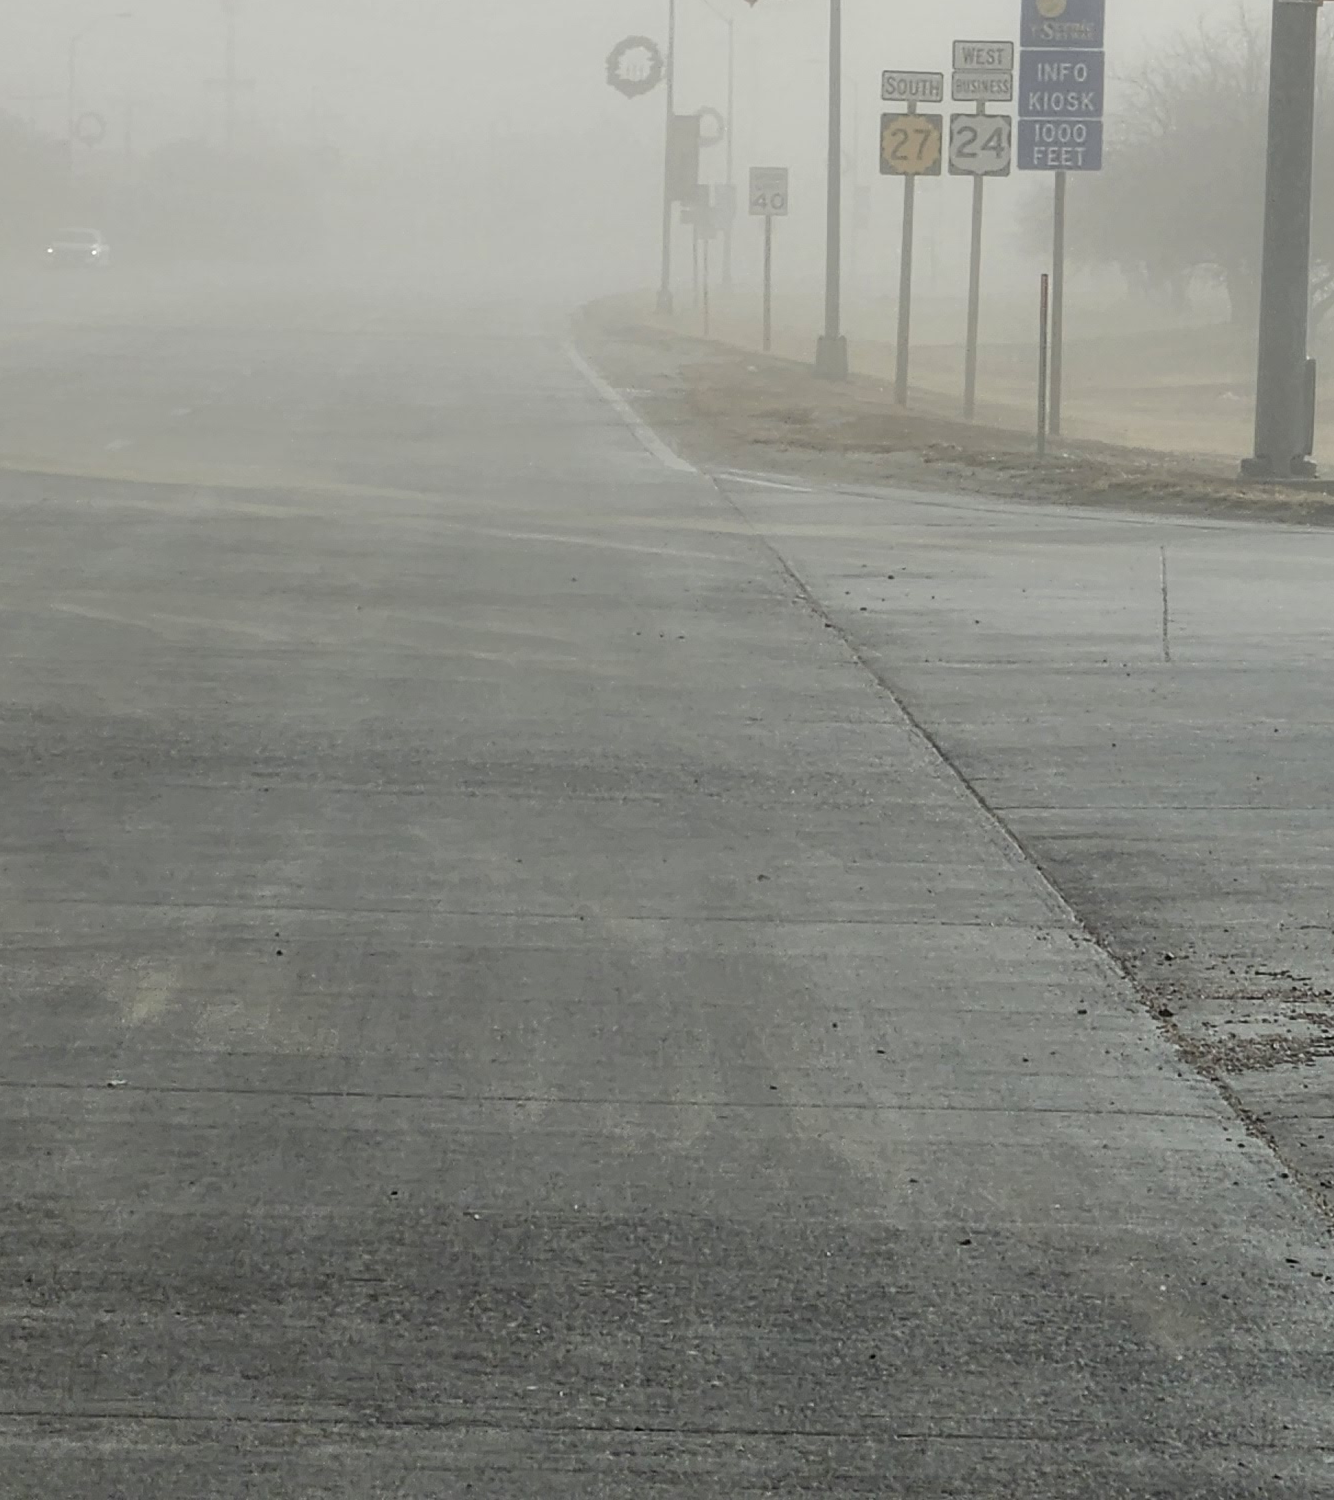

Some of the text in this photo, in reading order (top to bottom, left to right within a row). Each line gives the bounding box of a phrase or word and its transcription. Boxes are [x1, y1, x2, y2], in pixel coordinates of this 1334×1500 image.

[962, 47, 1005, 65] WEST
[1037, 63, 1087, 82] INFO
[885, 76, 940, 97] SOUTH
[955, 79, 1009, 94] BUSINESS
[1028, 91, 1095, 112] KIOSK
[955, 125, 1005, 159] 24
[1034, 124, 1087, 143] 1000
[890, 128, 932, 160] 27
[1033, 147, 1086, 166] FEET
[752, 192, 785, 210] 40
